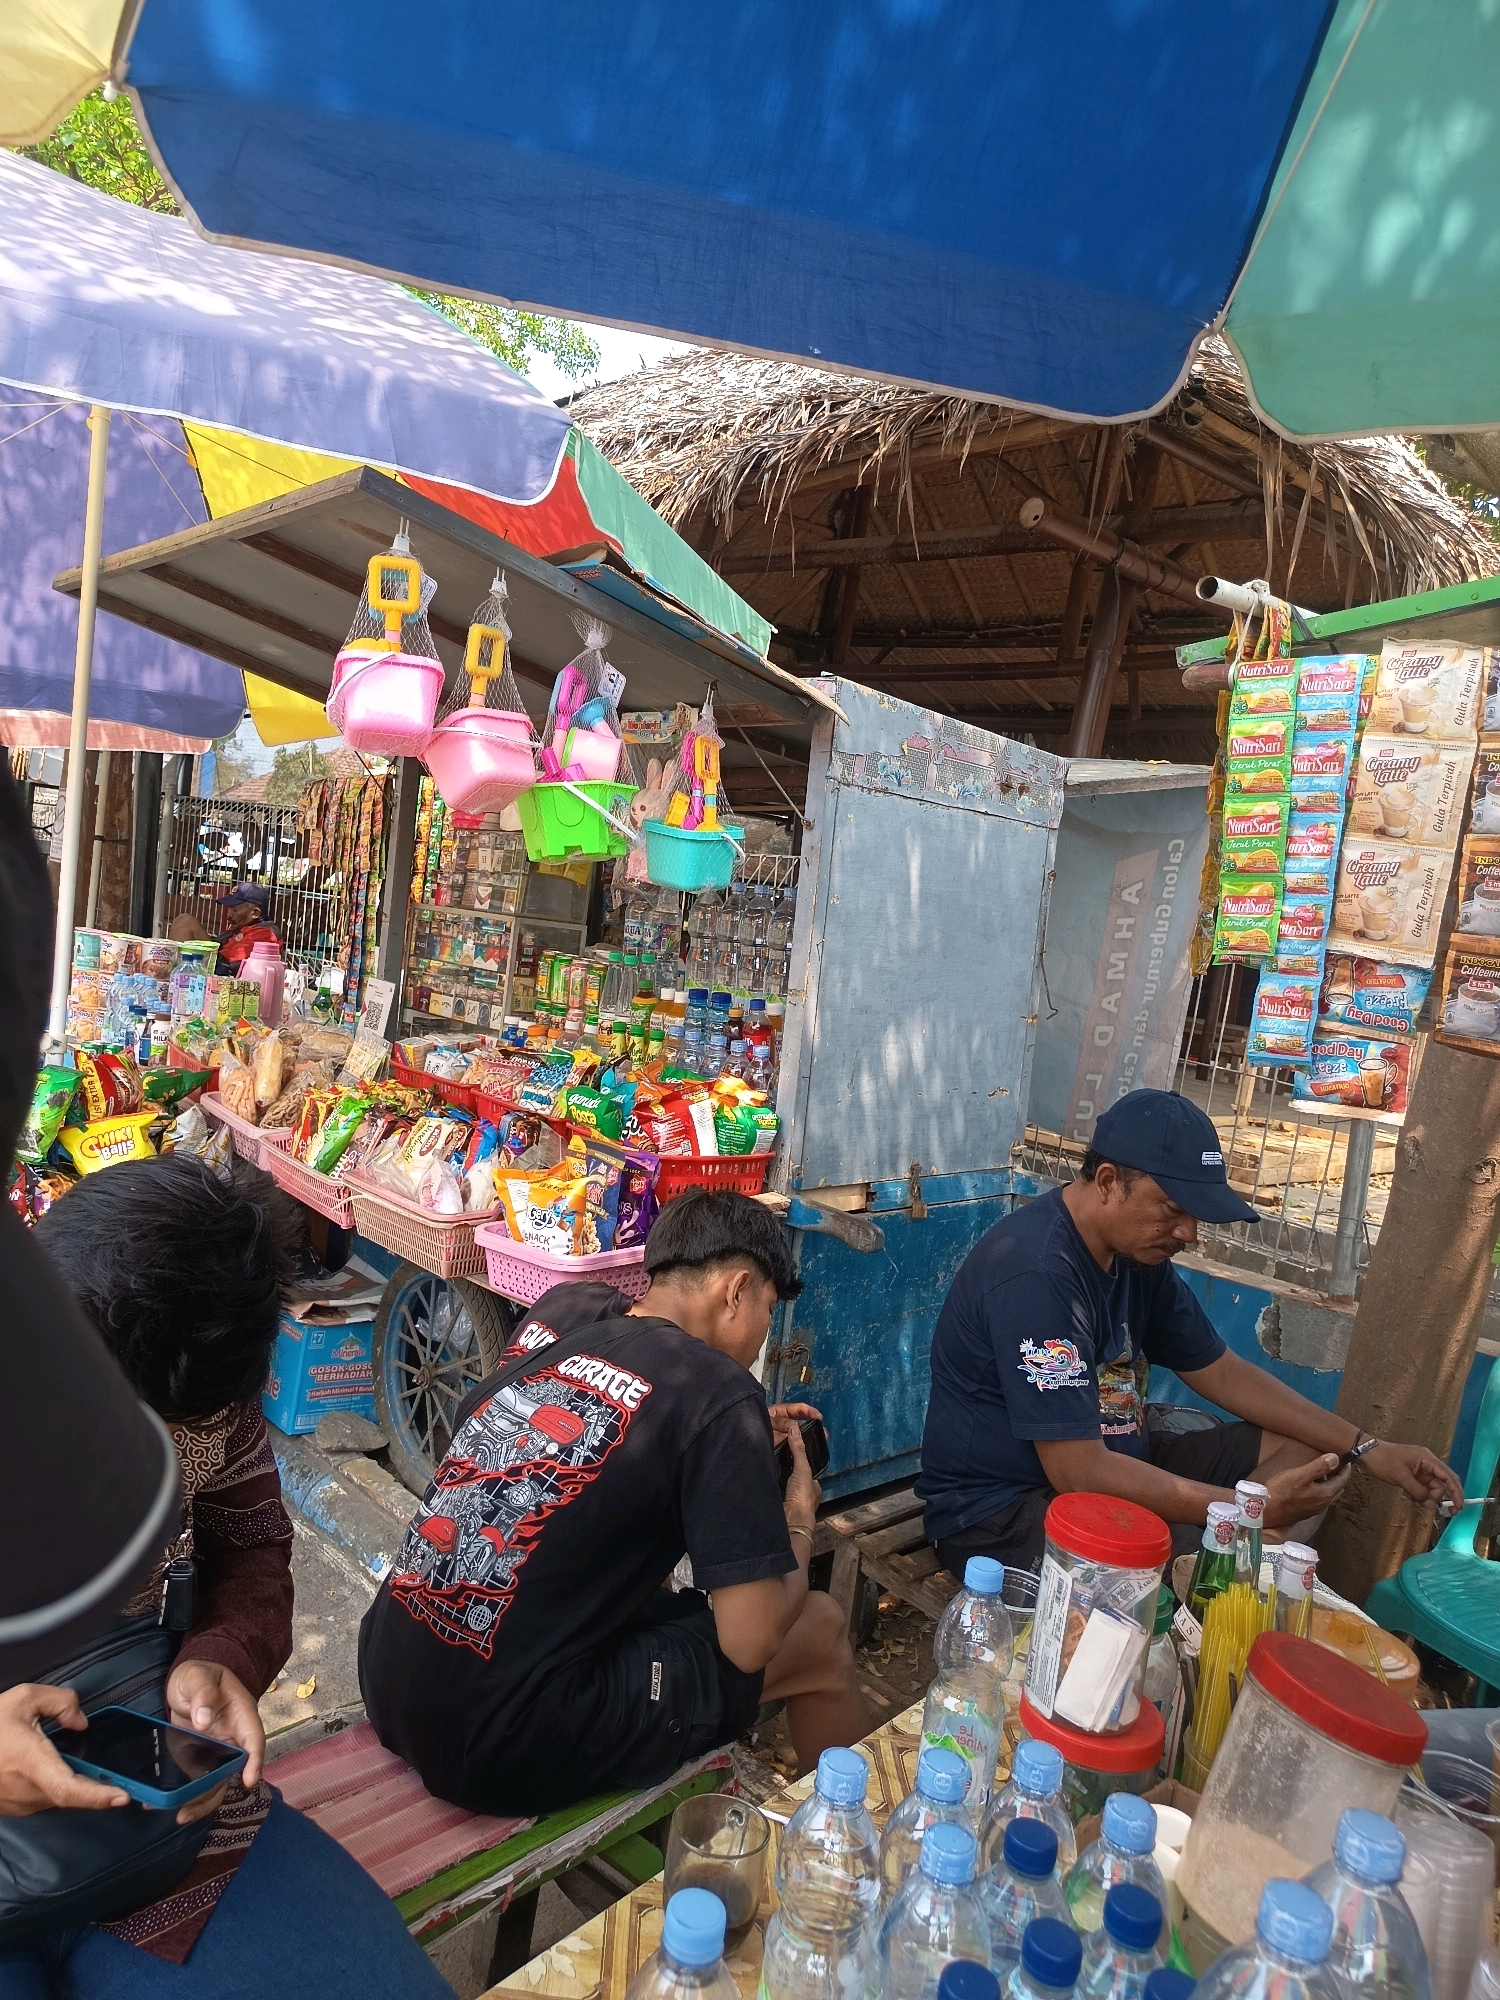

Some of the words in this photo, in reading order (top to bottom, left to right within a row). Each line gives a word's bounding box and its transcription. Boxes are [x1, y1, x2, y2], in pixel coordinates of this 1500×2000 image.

[1239, 662, 1290, 678] NutriSari
[1387, 655, 1444, 671] Creamy
[1395, 666, 1430, 684] Latte
[1459, 657, 1480, 700] Terpisah
[1238, 681, 1263, 691] Jeruk
[1264, 679, 1288, 689] Peras
[1300, 675, 1351, 693] NutriSari
[1453, 703, 1468, 726] Gula
[1231, 738, 1280, 755] NutriSari
[1230, 761, 1257, 770] Jeruk
[1258, 760, 1281, 768] Peras
[1292, 756, 1339, 773] NutriSari
[1366, 757, 1421, 773] Creamy
[1374, 768, 1408, 787] Latte
[1437, 761, 1457, 805] Terpisah
[1228, 817, 1276, 834] NutriSari
[1432, 808, 1446, 833] Gula
[1226, 840, 1251, 849] Jeruk
[1252, 839, 1275, 848] Peras
[1347, 860, 1401, 876] Creamy
[1354, 873, 1390, 890] Latte
[1417, 867, 1435, 911] Terpisah
[1224, 898, 1271, 913] NutriSari
[1221, 918, 1244, 927] Jeruk
[1411, 914, 1425, 938] Gula
[1460, 955, 1500, 968] INDOCA
[1260, 997, 1307, 1017] NutriSari
[1366, 990, 1409, 1010] Freeze
[1345, 1005, 1373, 1026] Day
[1373, 1013, 1410, 1034] Good
[1280, 1021, 1305, 1033] Orange
[1312, 1042, 1336, 1056] ood
[1337, 1042, 1364, 1060] Day
[1313, 1061, 1347, 1074] reeze
[80, 1125, 134, 1159] CHIKI
[100, 1139, 136, 1160] Balls
[524, 1233, 552, 1245] SNACK
[331, 1349, 366, 1359] Minerale
[344, 1342, 355, 1350] Le
[310, 1362, 373, 1375] GOSOK-GOS
[317, 1370, 373, 1381] BERHADIAH
[558, 1355, 650, 1409] GARAGE
[311, 1389, 331, 1397] Hadiah
[332, 1387, 355, 1395] Minimal
[1115, 1580, 1131, 1596] HALAL
